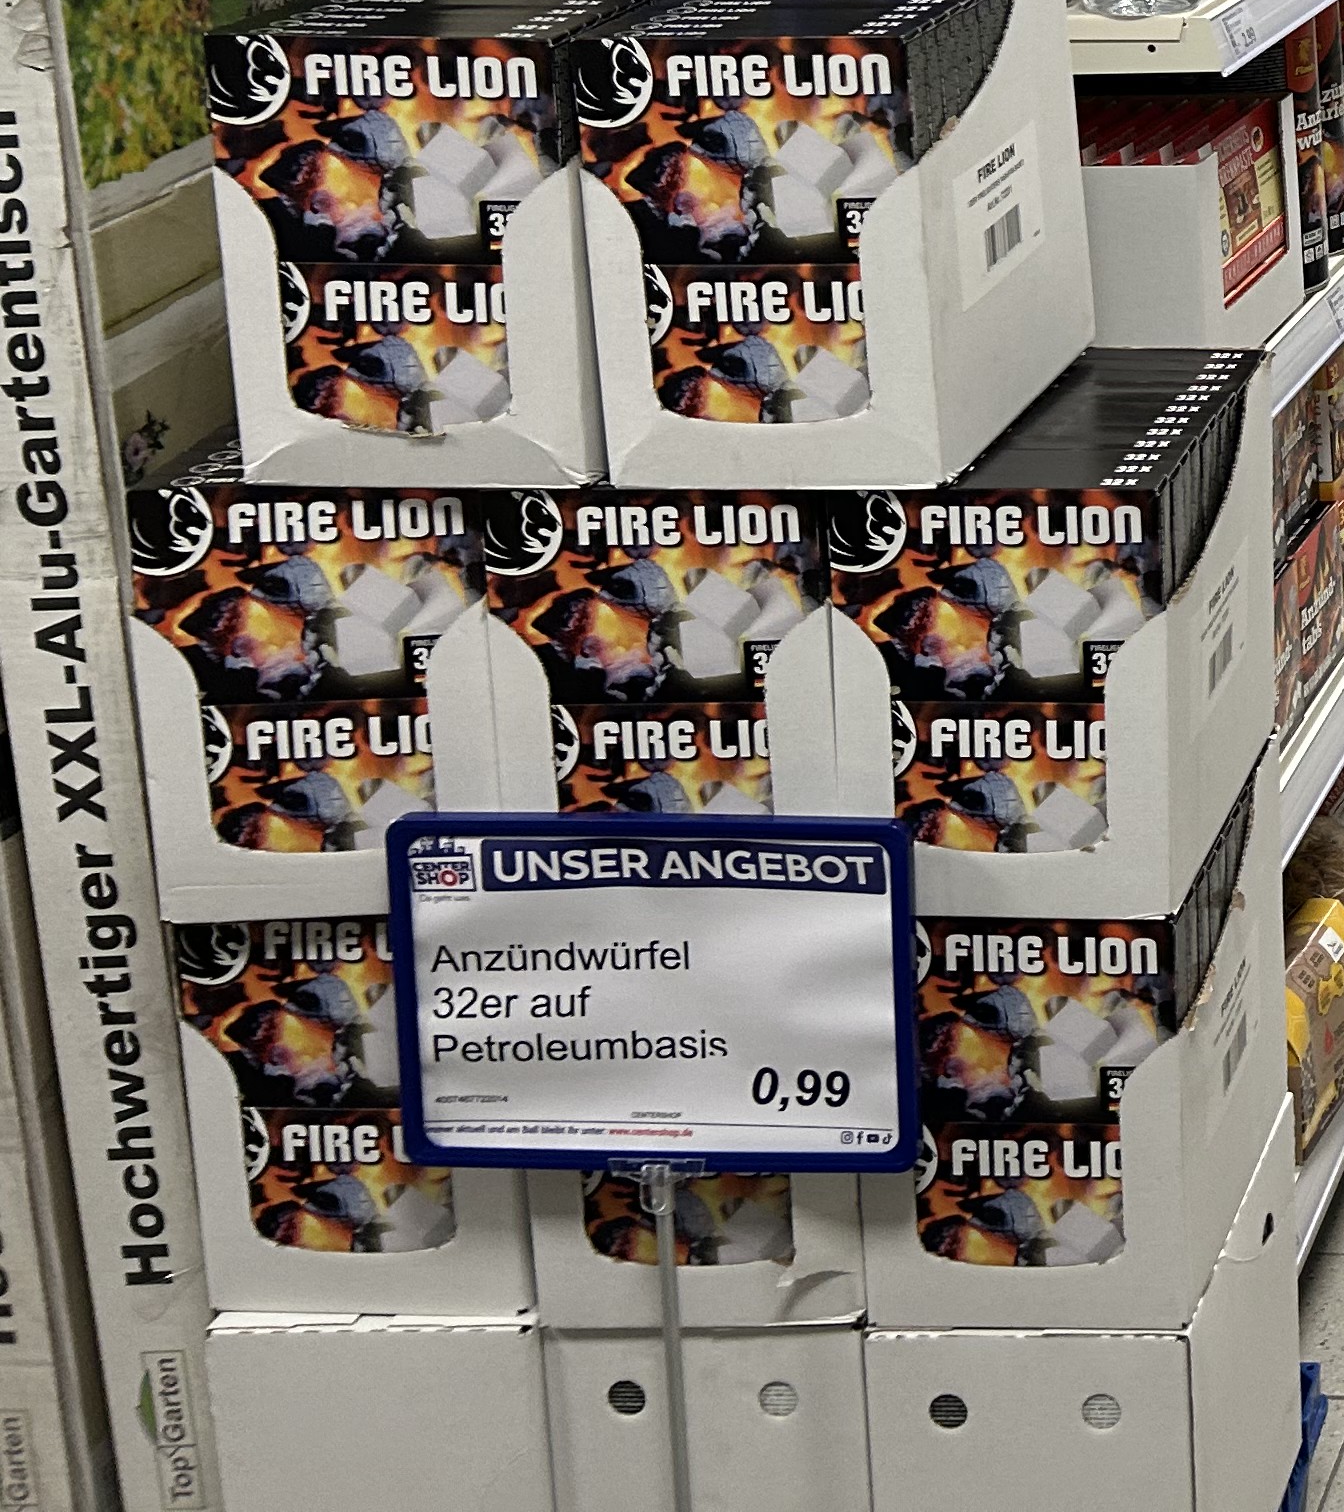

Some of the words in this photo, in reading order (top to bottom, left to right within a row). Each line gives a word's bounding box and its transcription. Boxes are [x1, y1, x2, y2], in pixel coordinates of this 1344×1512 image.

[304, 51, 414, 97] FIRE
[435, 54, 538, 99] LION
[667, 53, 773, 97] FIRE
[789, 54, 892, 97] LION
[977, 158, 997, 184] FIRE
[997, 143, 1016, 169] LION
[324, 280, 432, 324] FIRE
[687, 281, 793, 324] FIRE
[0, 112, 104, 823] XXL-Alu-Gartentisch
[228, 498, 338, 543] FIRE
[354, 495, 465, 540] LION
[577, 503, 682, 547] FIRE
[694, 503, 801, 546] LION
[920, 504, 1025, 546] FIRE
[1037, 504, 1142, 546] LION
[413, 861, 470, 874] CENTER
[415, 869, 470, 888] SHOP
[492, 847, 649, 885] UNSER
[660, 848, 874, 887] ANGEBOT
[431, 941, 691, 974] Anzündwürfel
[945, 935, 1045, 976] FIRE
[1057, 935, 1159, 976] LION
[432, 988, 518, 1020] 32er
[530, 986, 592, 1018] auf
[76, 841, 174, 1288] Hochwertiger
[432, 1030, 728, 1063] Petroleumbasis
[751, 1067, 851, 1112] 0,99
[951, 1138, 1049, 1179] FIRE
[157, 1355, 190, 1444] Garten
[169, 1447, 195, 1502] Top
